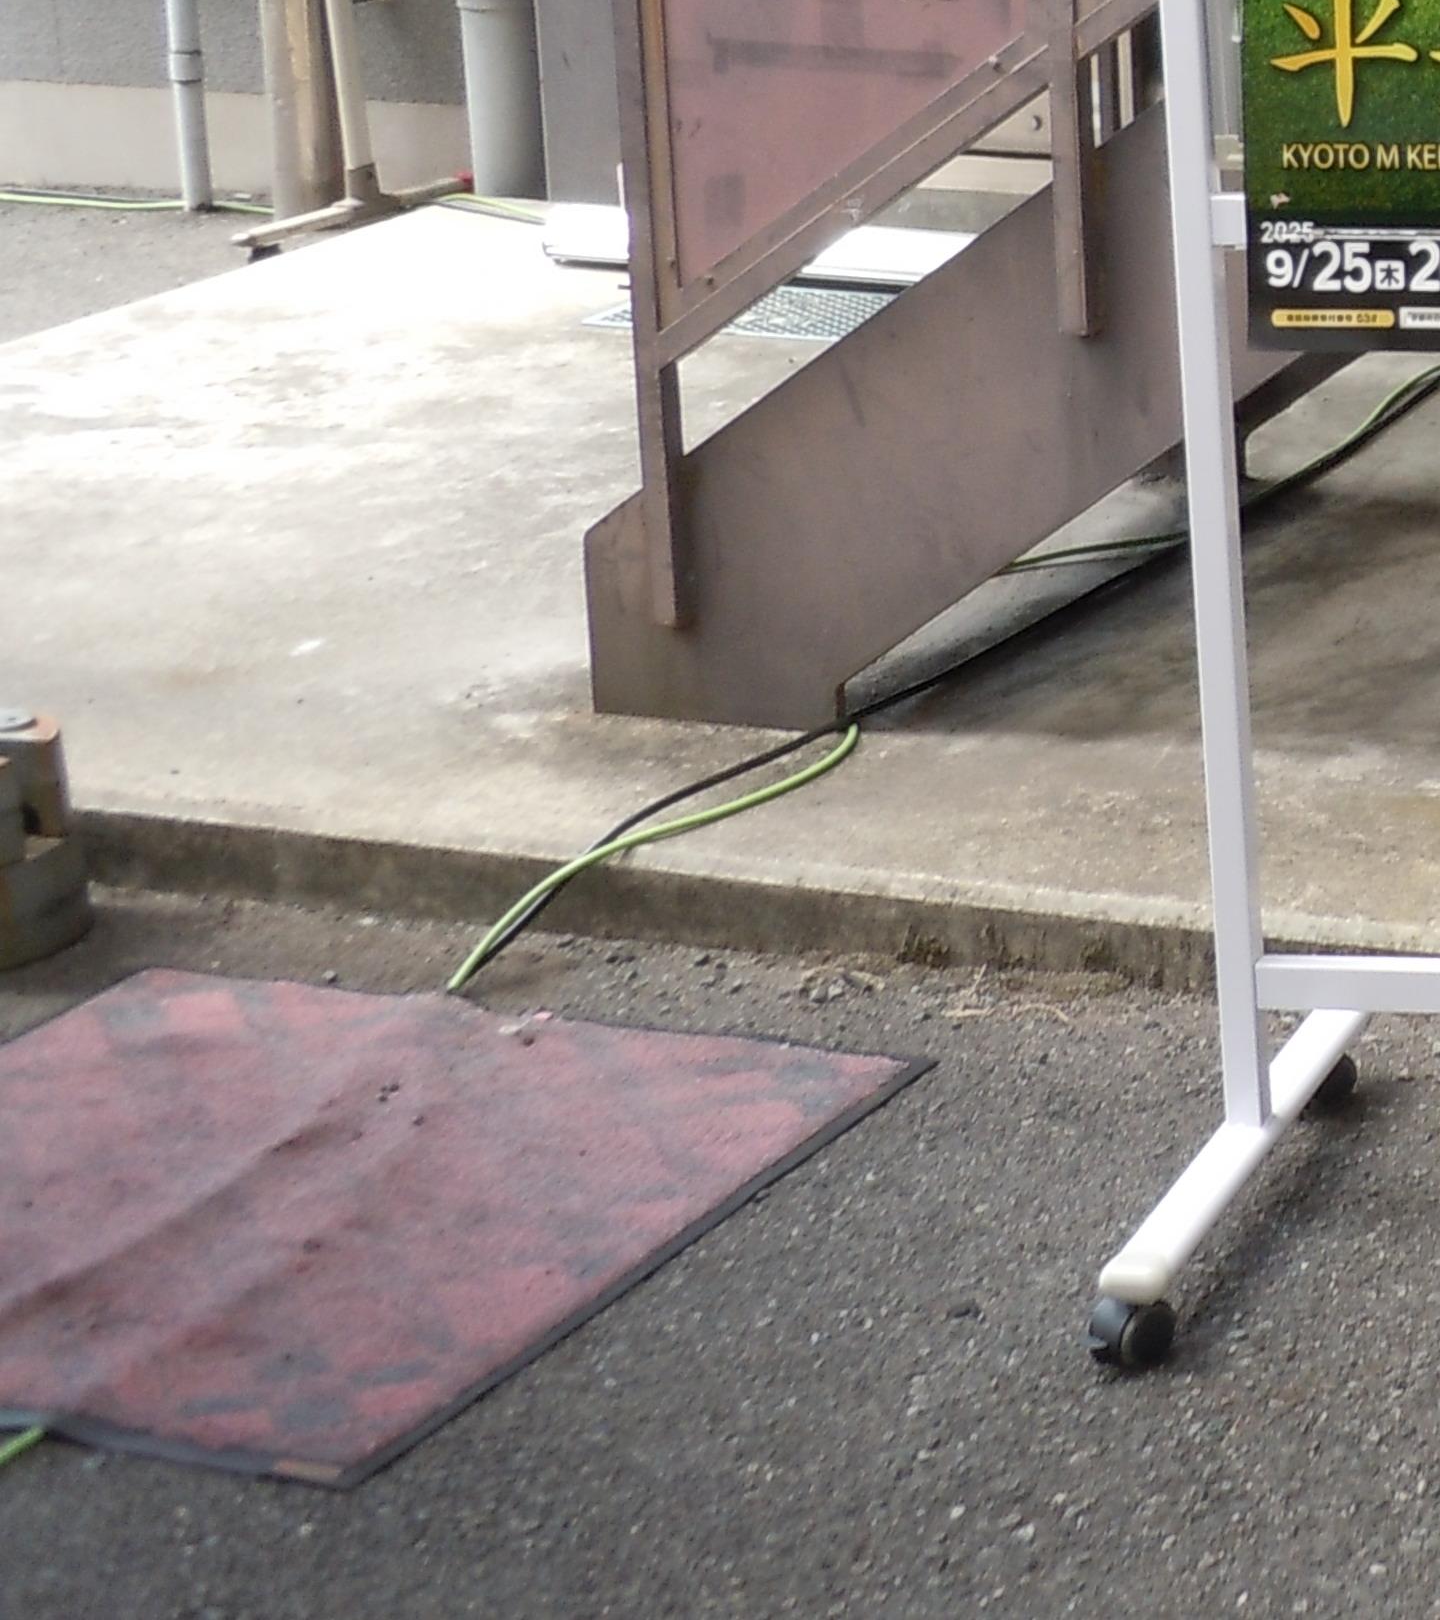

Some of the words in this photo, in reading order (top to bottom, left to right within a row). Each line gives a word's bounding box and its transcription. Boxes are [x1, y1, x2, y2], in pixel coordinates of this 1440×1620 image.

[1282, 145, 1370, 171] KYOTO
[1376, 145, 1400, 171] M
[1260, 220, 1316, 245] 2025
